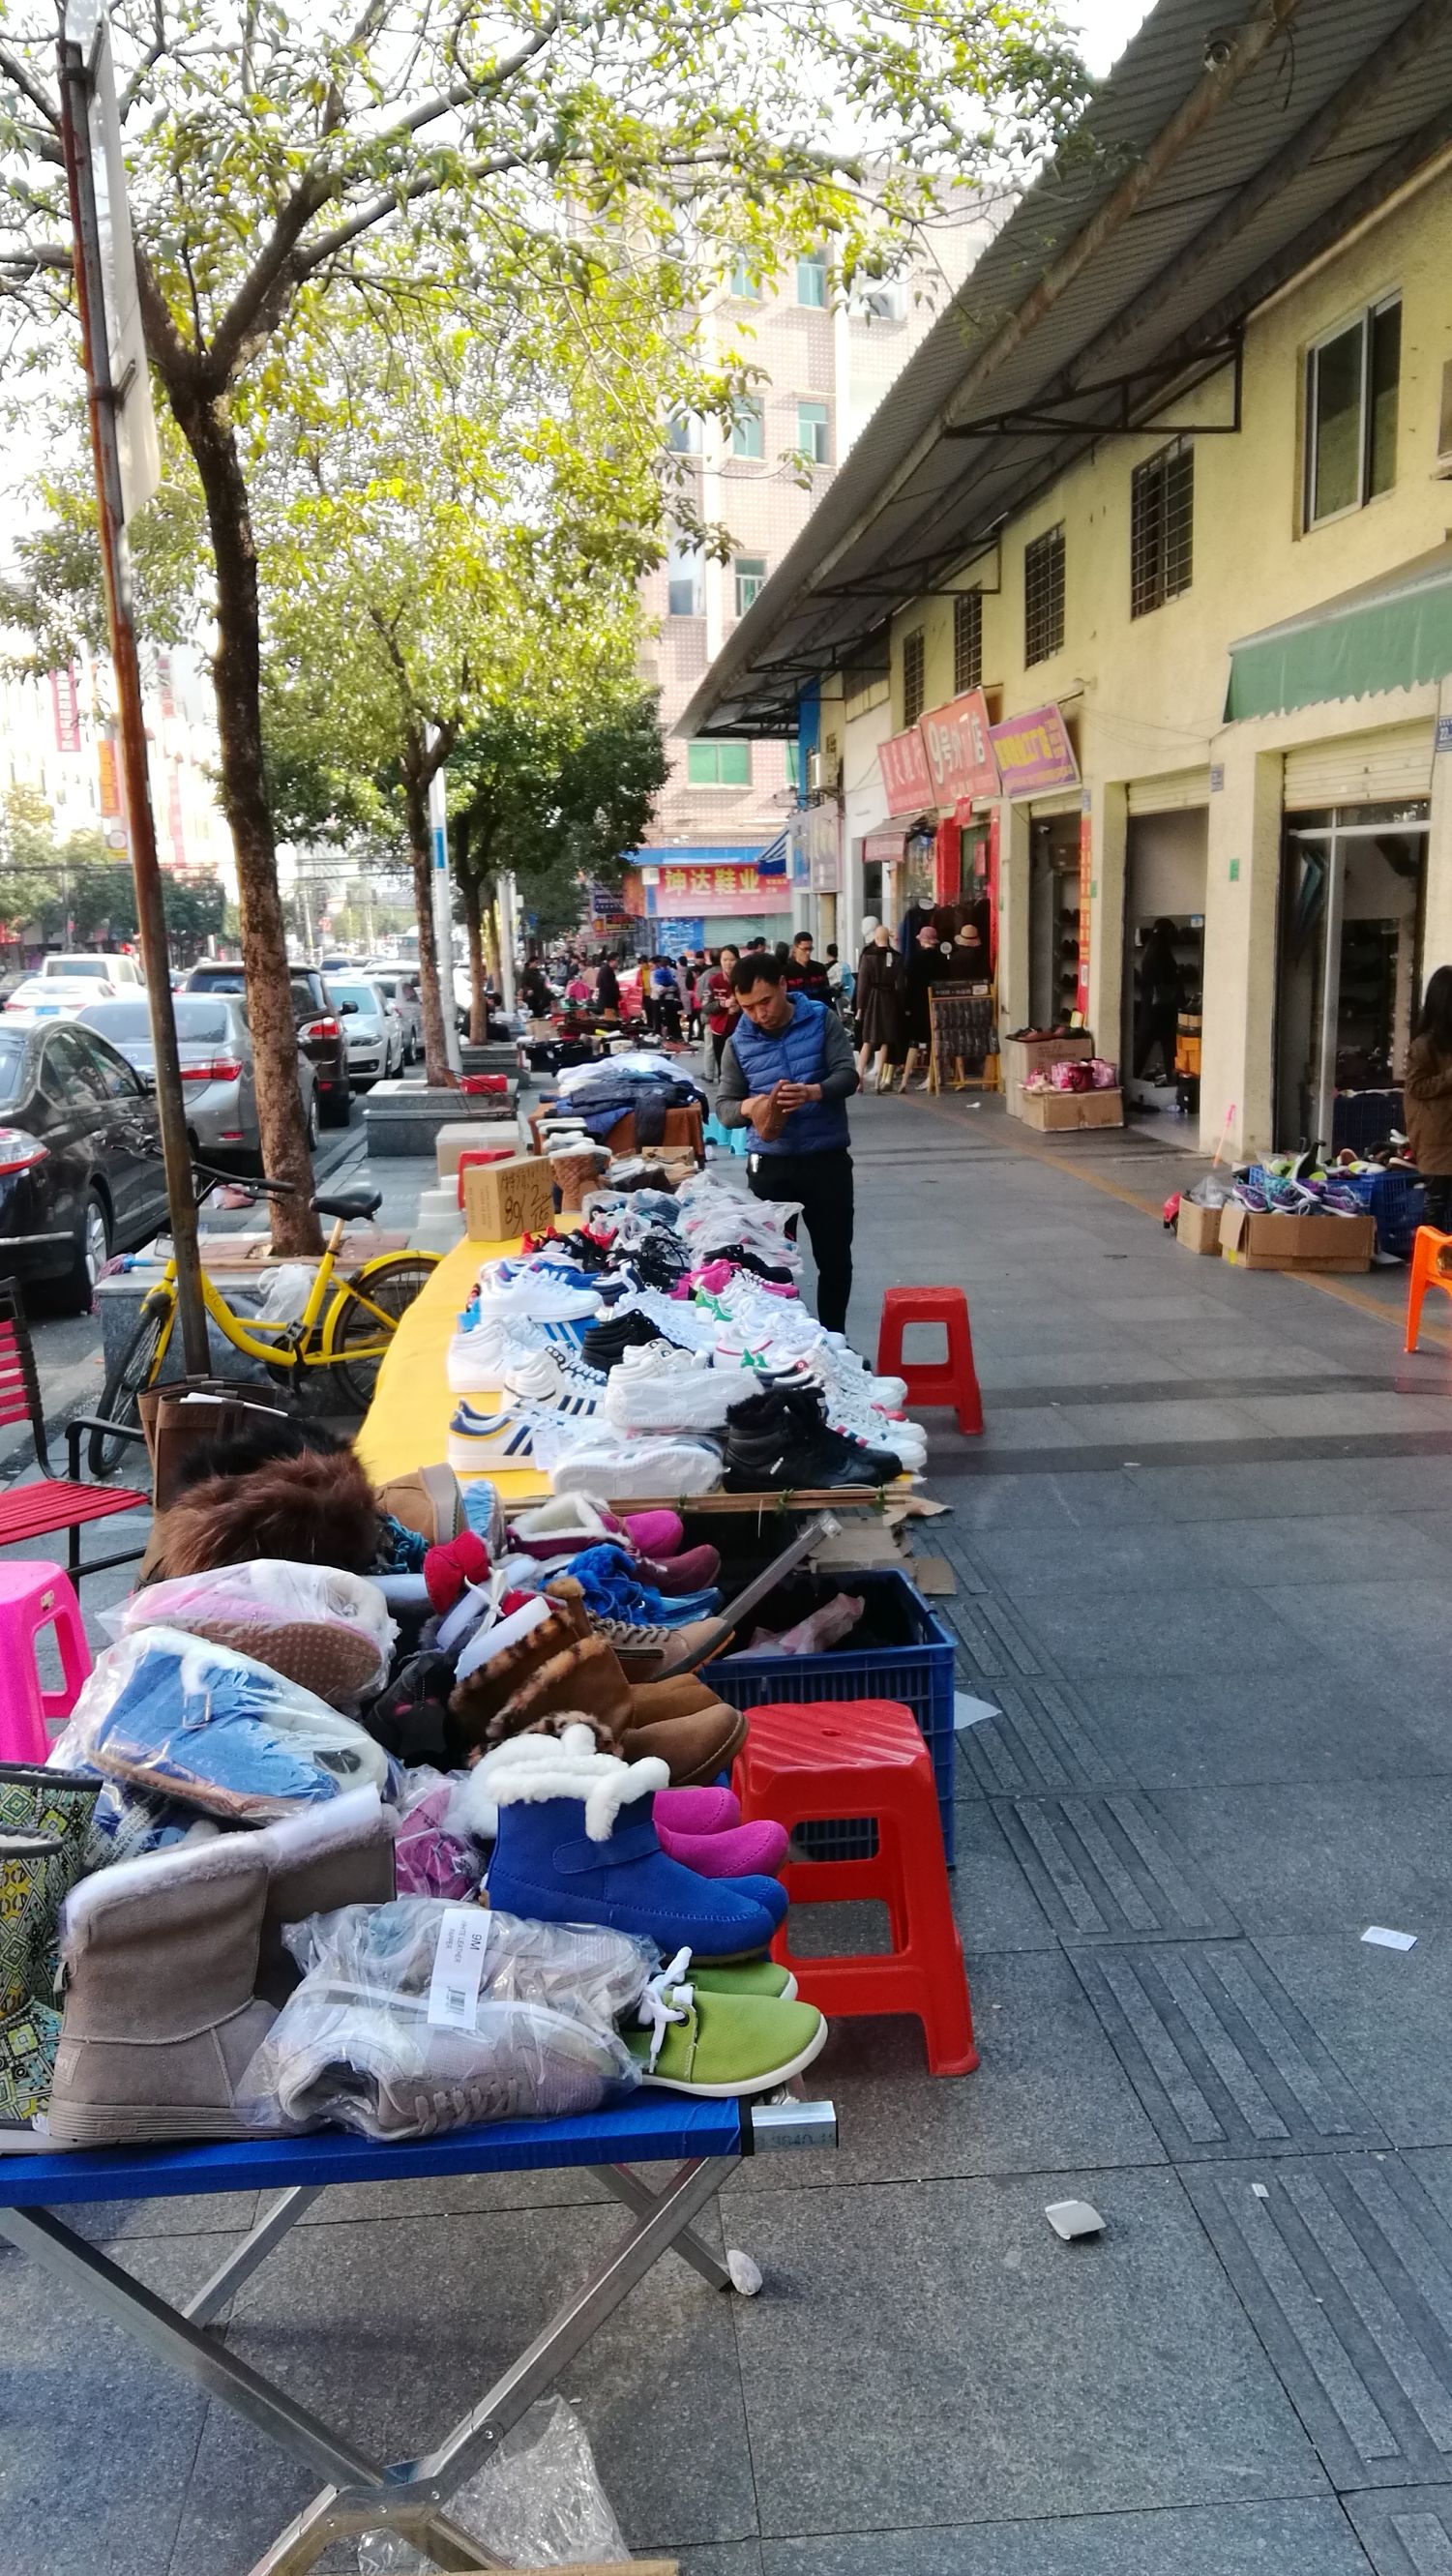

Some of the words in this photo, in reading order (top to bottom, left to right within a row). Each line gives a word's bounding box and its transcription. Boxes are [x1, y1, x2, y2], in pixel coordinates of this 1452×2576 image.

[665, 868, 760, 897] 坤达鞋业
[454, 1937, 466, 1964] LEATHER
[469, 1934, 483, 1951] 9M
